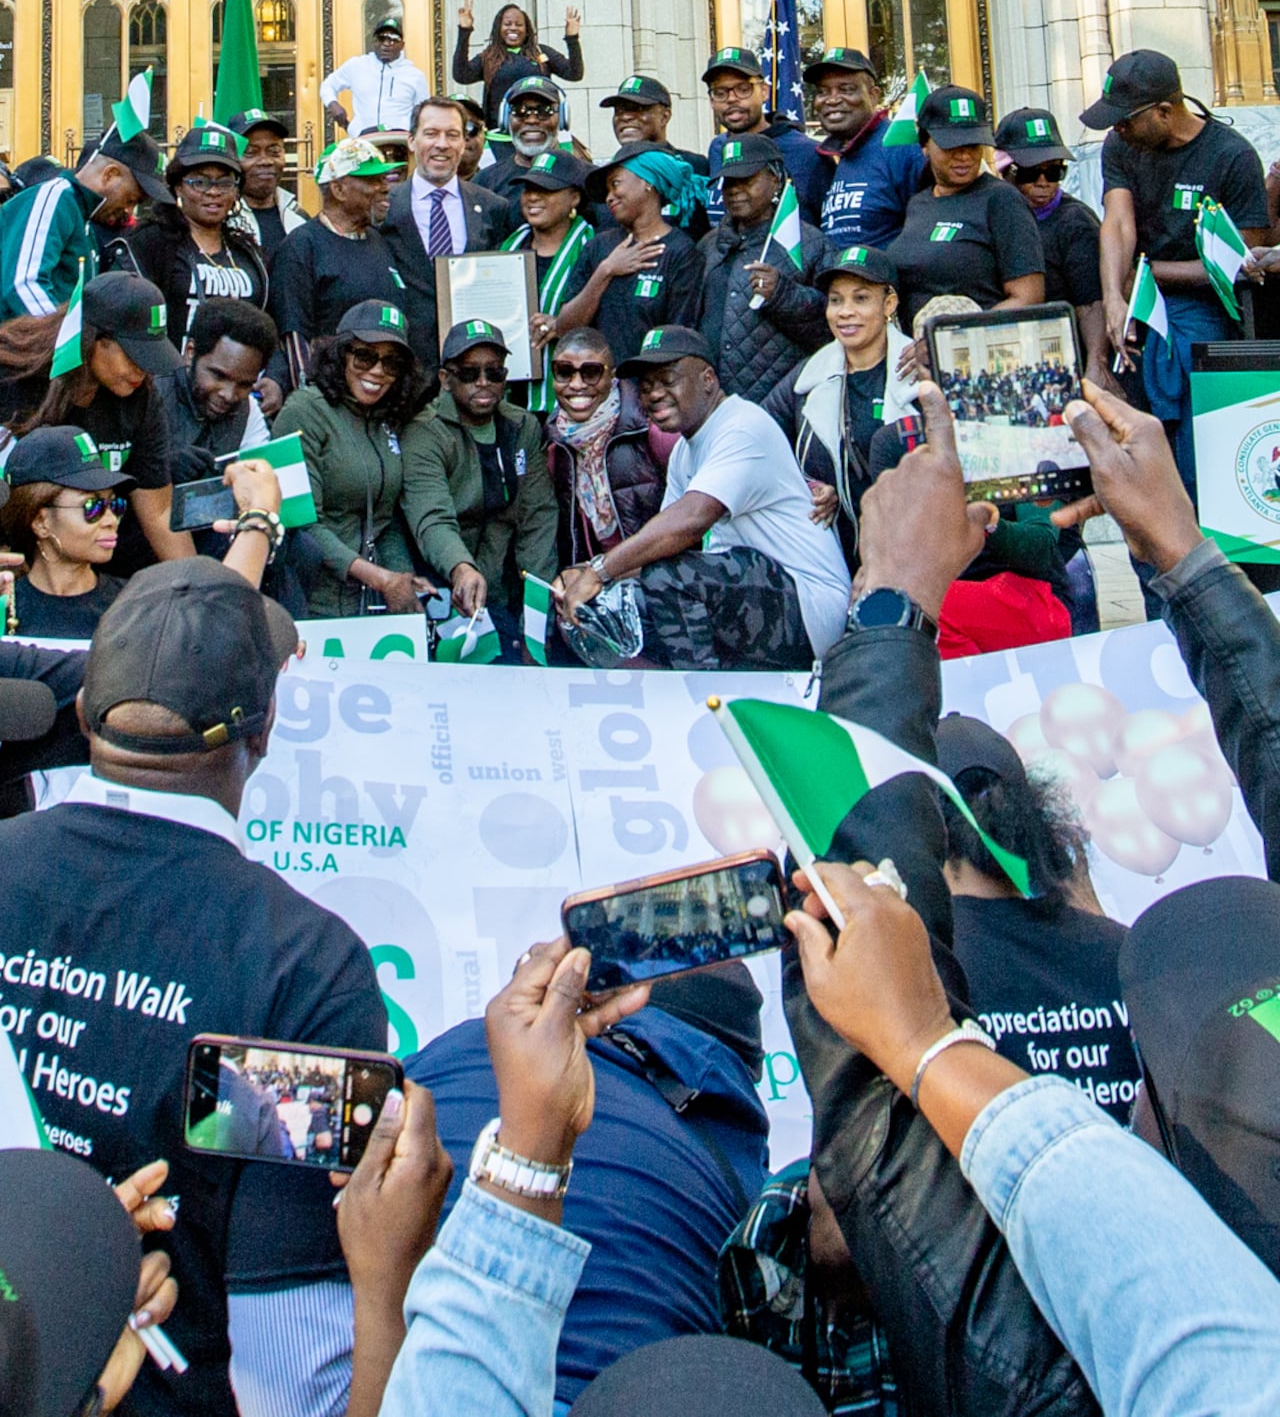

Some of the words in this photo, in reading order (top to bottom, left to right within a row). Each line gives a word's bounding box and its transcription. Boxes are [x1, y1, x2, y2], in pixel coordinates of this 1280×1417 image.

[1238, 429, 1261, 473] CONSULATE
[1243, 485, 1269, 516] ATLANTA
[428, 703, 453, 785] official
[545, 729, 566, 782] west
[468, 762, 542, 782] union
[246, 819, 283, 842] OF
[292, 821, 407, 848] NIGERIA
[273, 851, 339, 873] U.S.A
[114, 969, 193, 1025] Walk
[1227, 998, 1254, 1017] 62
[37, 1011, 86, 1048] our
[1027, 1041, 1059, 1070] for
[1066, 1044, 1109, 1068] our
[32, 1048, 132, 1116] Heroes
